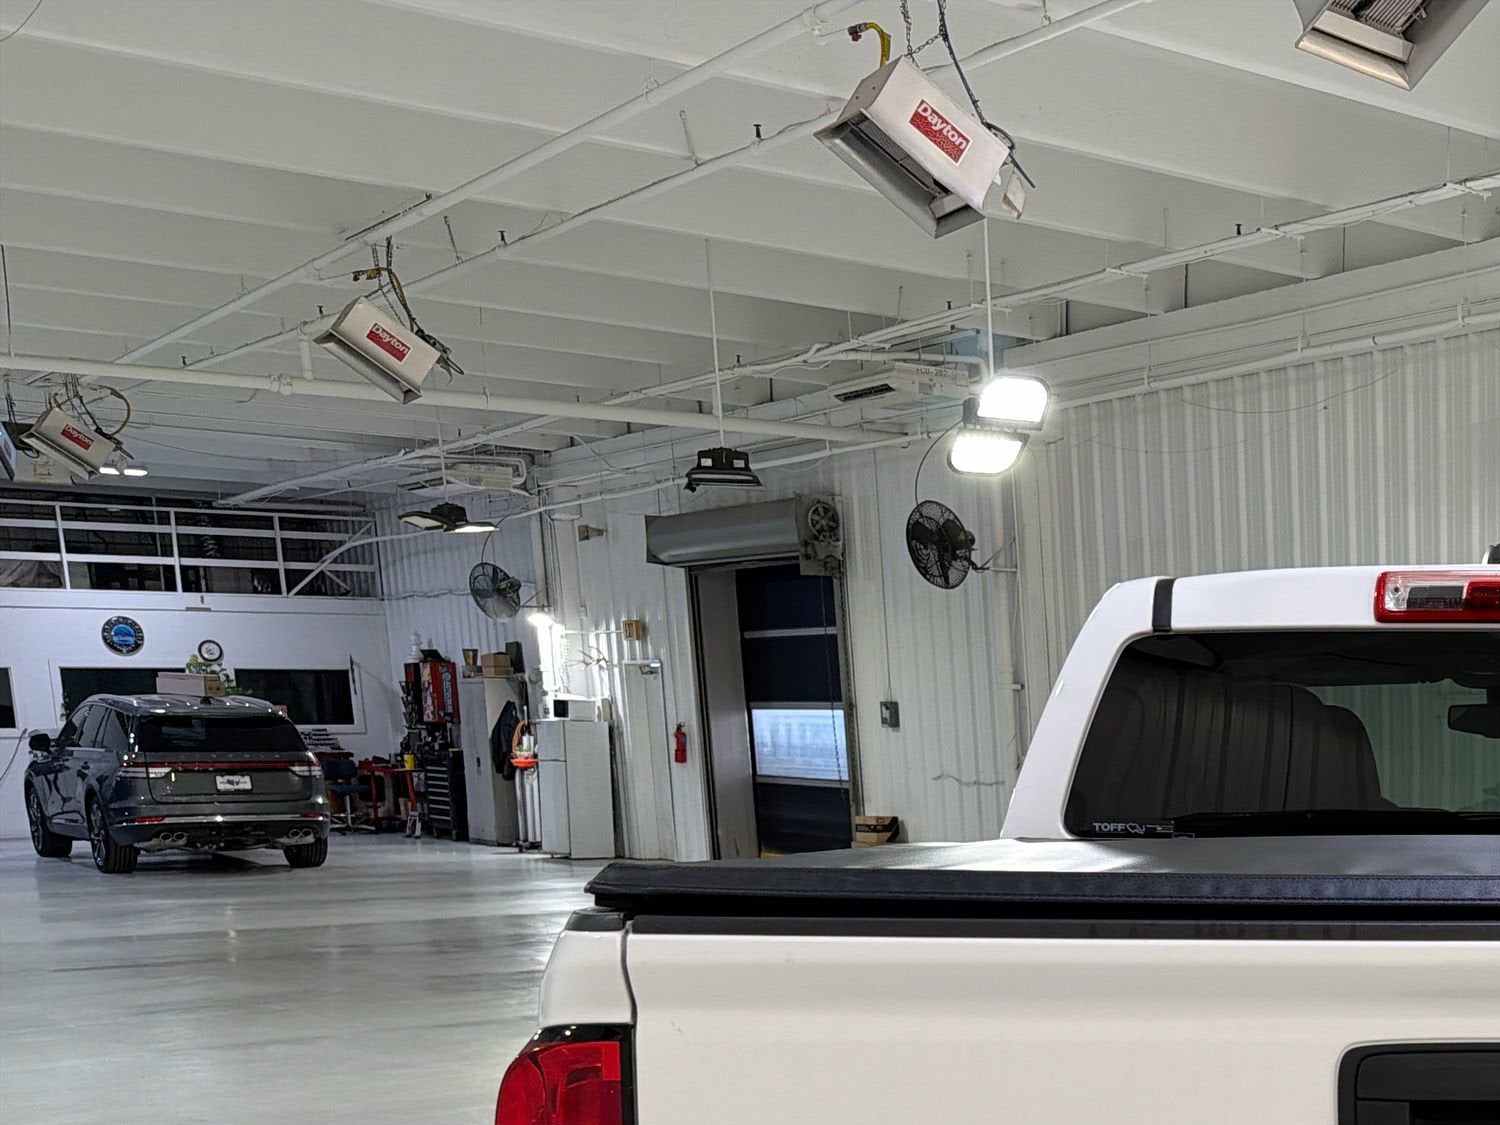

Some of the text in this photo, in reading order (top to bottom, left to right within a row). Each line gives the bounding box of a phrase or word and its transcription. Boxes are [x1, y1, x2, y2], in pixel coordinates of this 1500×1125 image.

[917, 102, 967, 150] Dayton
[372, 325, 409, 354] Dayton
[65, 425, 92, 445] Dayton
